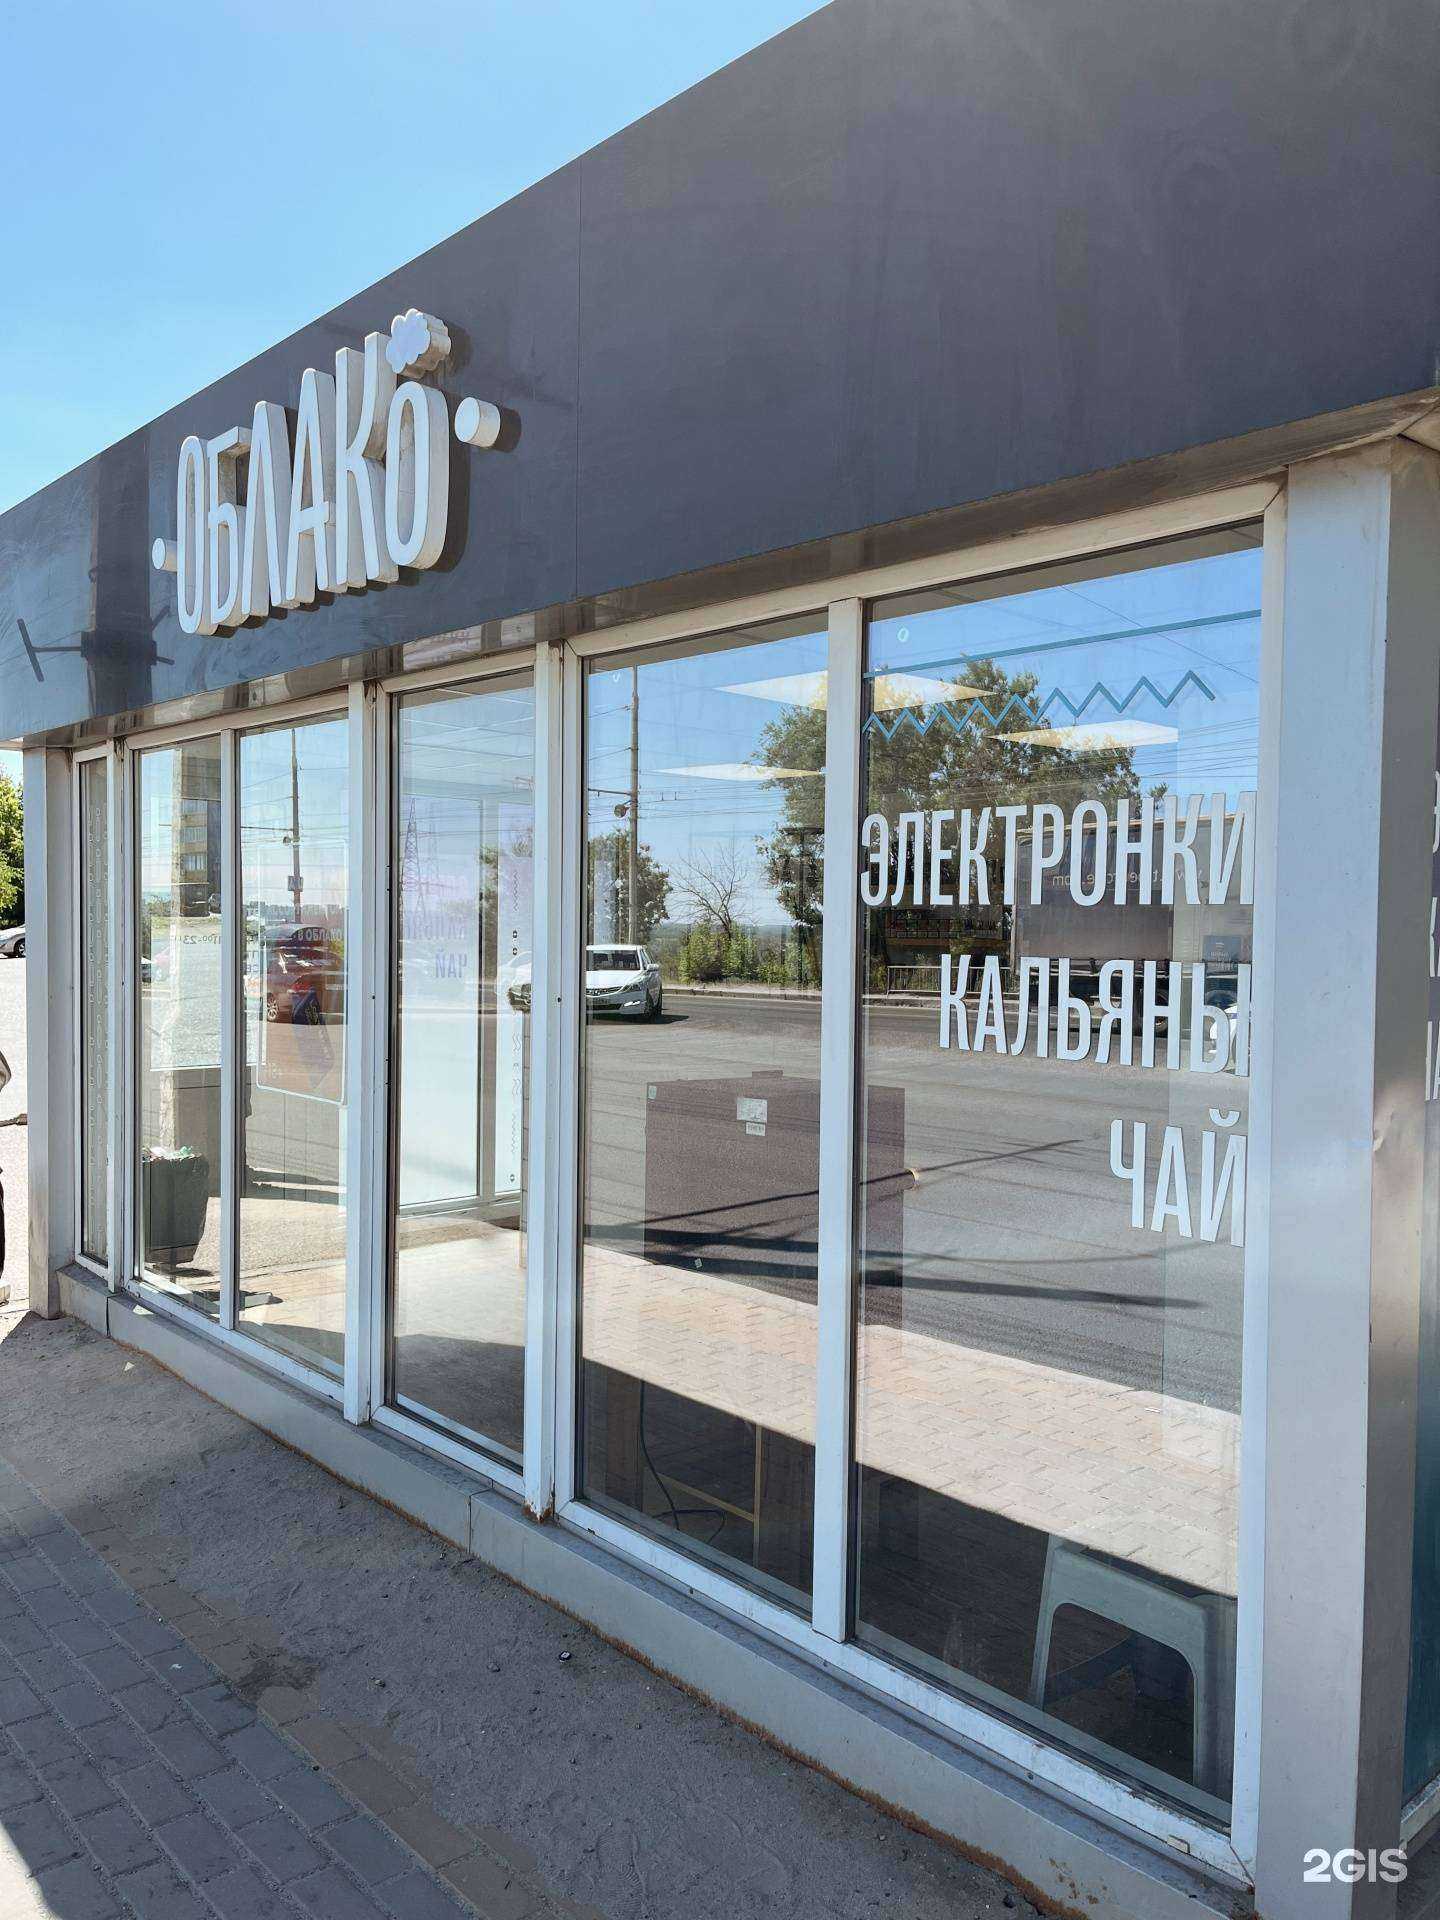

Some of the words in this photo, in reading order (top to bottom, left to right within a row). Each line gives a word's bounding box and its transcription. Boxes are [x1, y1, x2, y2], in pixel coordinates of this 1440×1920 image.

[177, 331, 449, 636] ОБЛАКО
[860, 790, 1258, 906] ЭЛЕКТРОНКИ
[938, 953, 1252, 1078] КАЛЬЯНЫ
[1110, 1108, 1248, 1248] ЧАЙ
